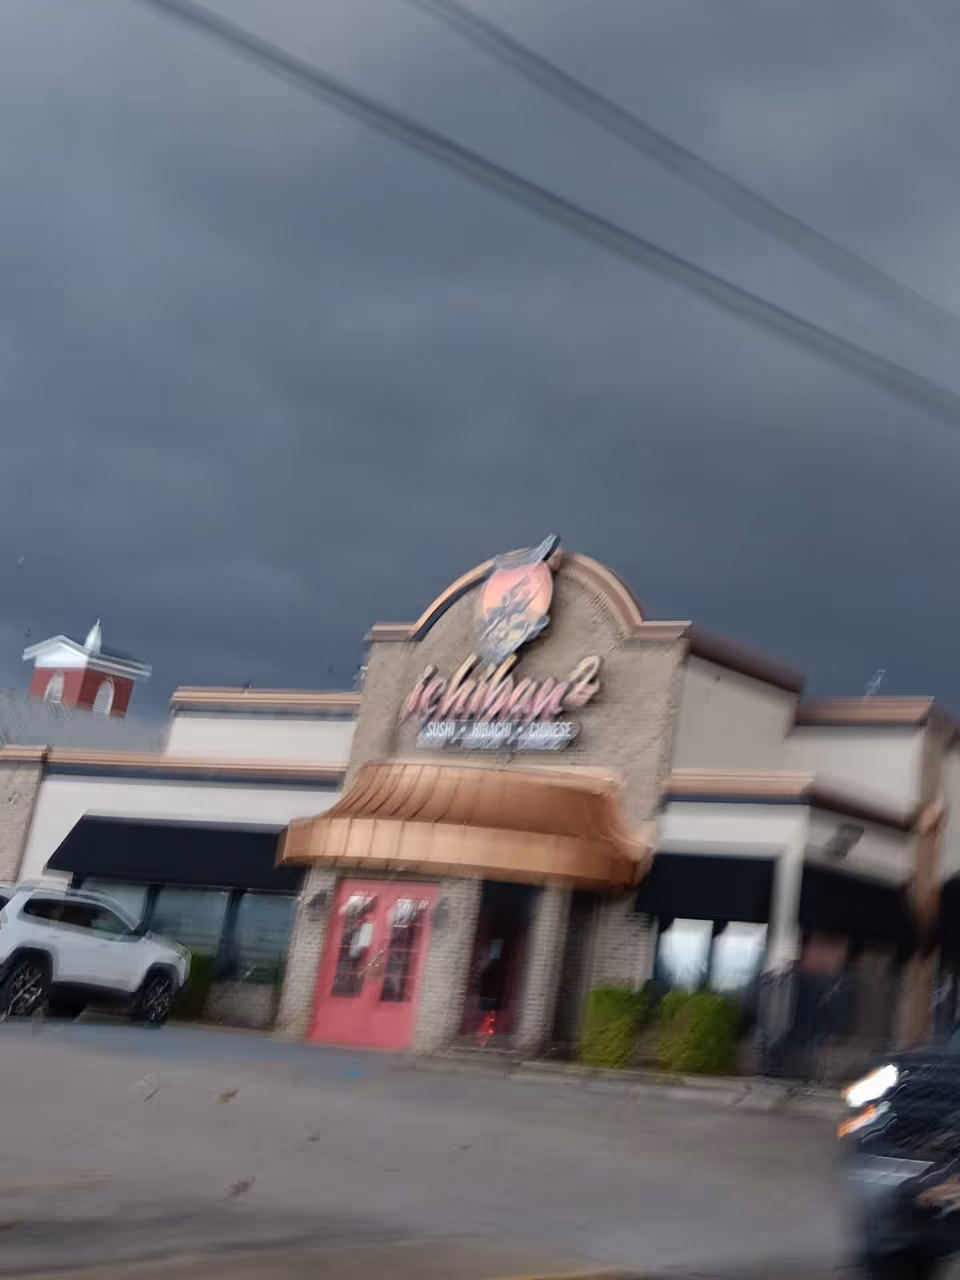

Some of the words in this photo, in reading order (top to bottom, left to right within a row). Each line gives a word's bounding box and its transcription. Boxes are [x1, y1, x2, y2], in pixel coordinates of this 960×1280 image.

[426, 721, 456, 737] SUSHI
[471, 721, 513, 737] HIBACHI
[529, 721, 574, 738] CHINESE
